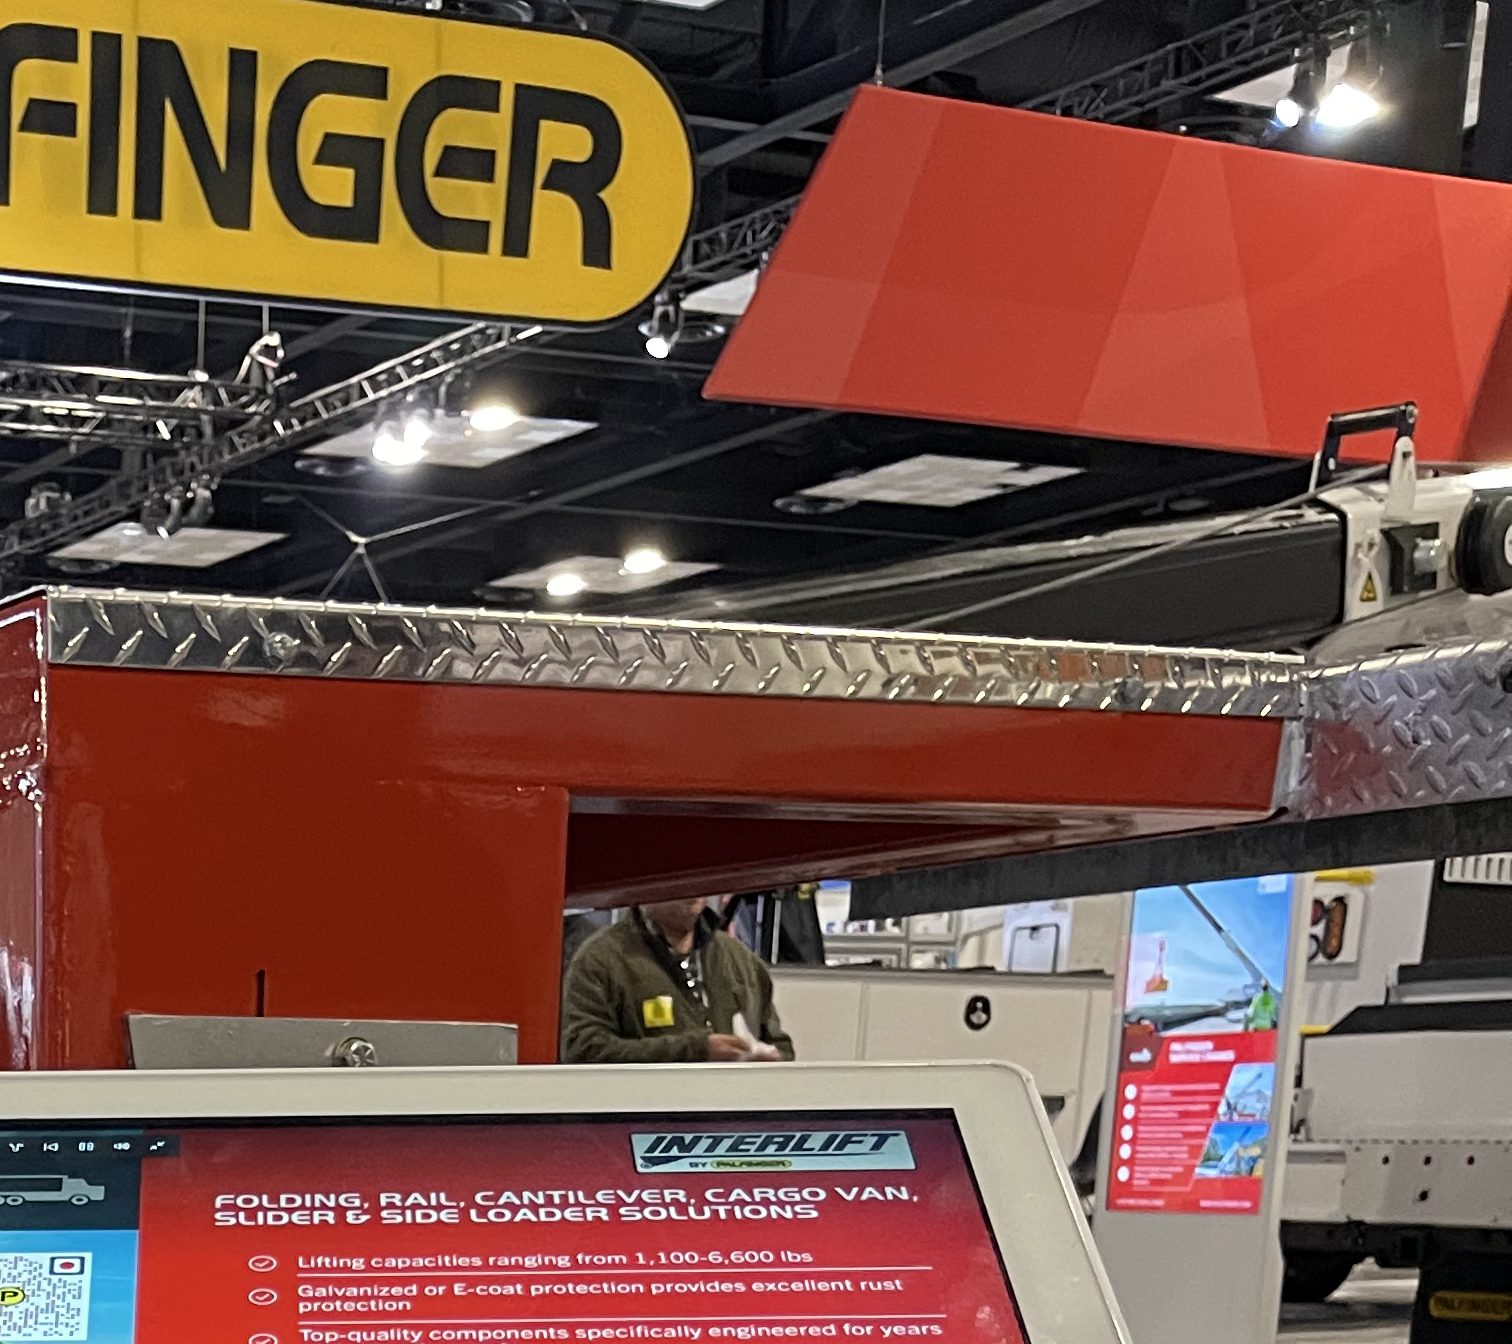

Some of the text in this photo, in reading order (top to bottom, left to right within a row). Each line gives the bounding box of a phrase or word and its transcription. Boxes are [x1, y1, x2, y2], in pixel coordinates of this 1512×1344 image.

[643, 1132, 901, 1154] INTERLIFT
[689, 1161, 708, 1169] BY
[215, 1186, 918, 1210] FOLDING, RAIL, CANTILEVER, CARGO VAN,
[215, 1204, 819, 1226] SLIDER & SIDE LOADER SOLUTIONS
[298, 1250, 813, 1271] Lifting capacities ranging from 1,100-6,600 lbs
[297, 1279, 904, 1298] Galvanized or E-coat protection provides excellent rust
[298, 1299, 412, 1314] protection
[299, 1323, 943, 1343] Top-quality components specifically engineered for years
